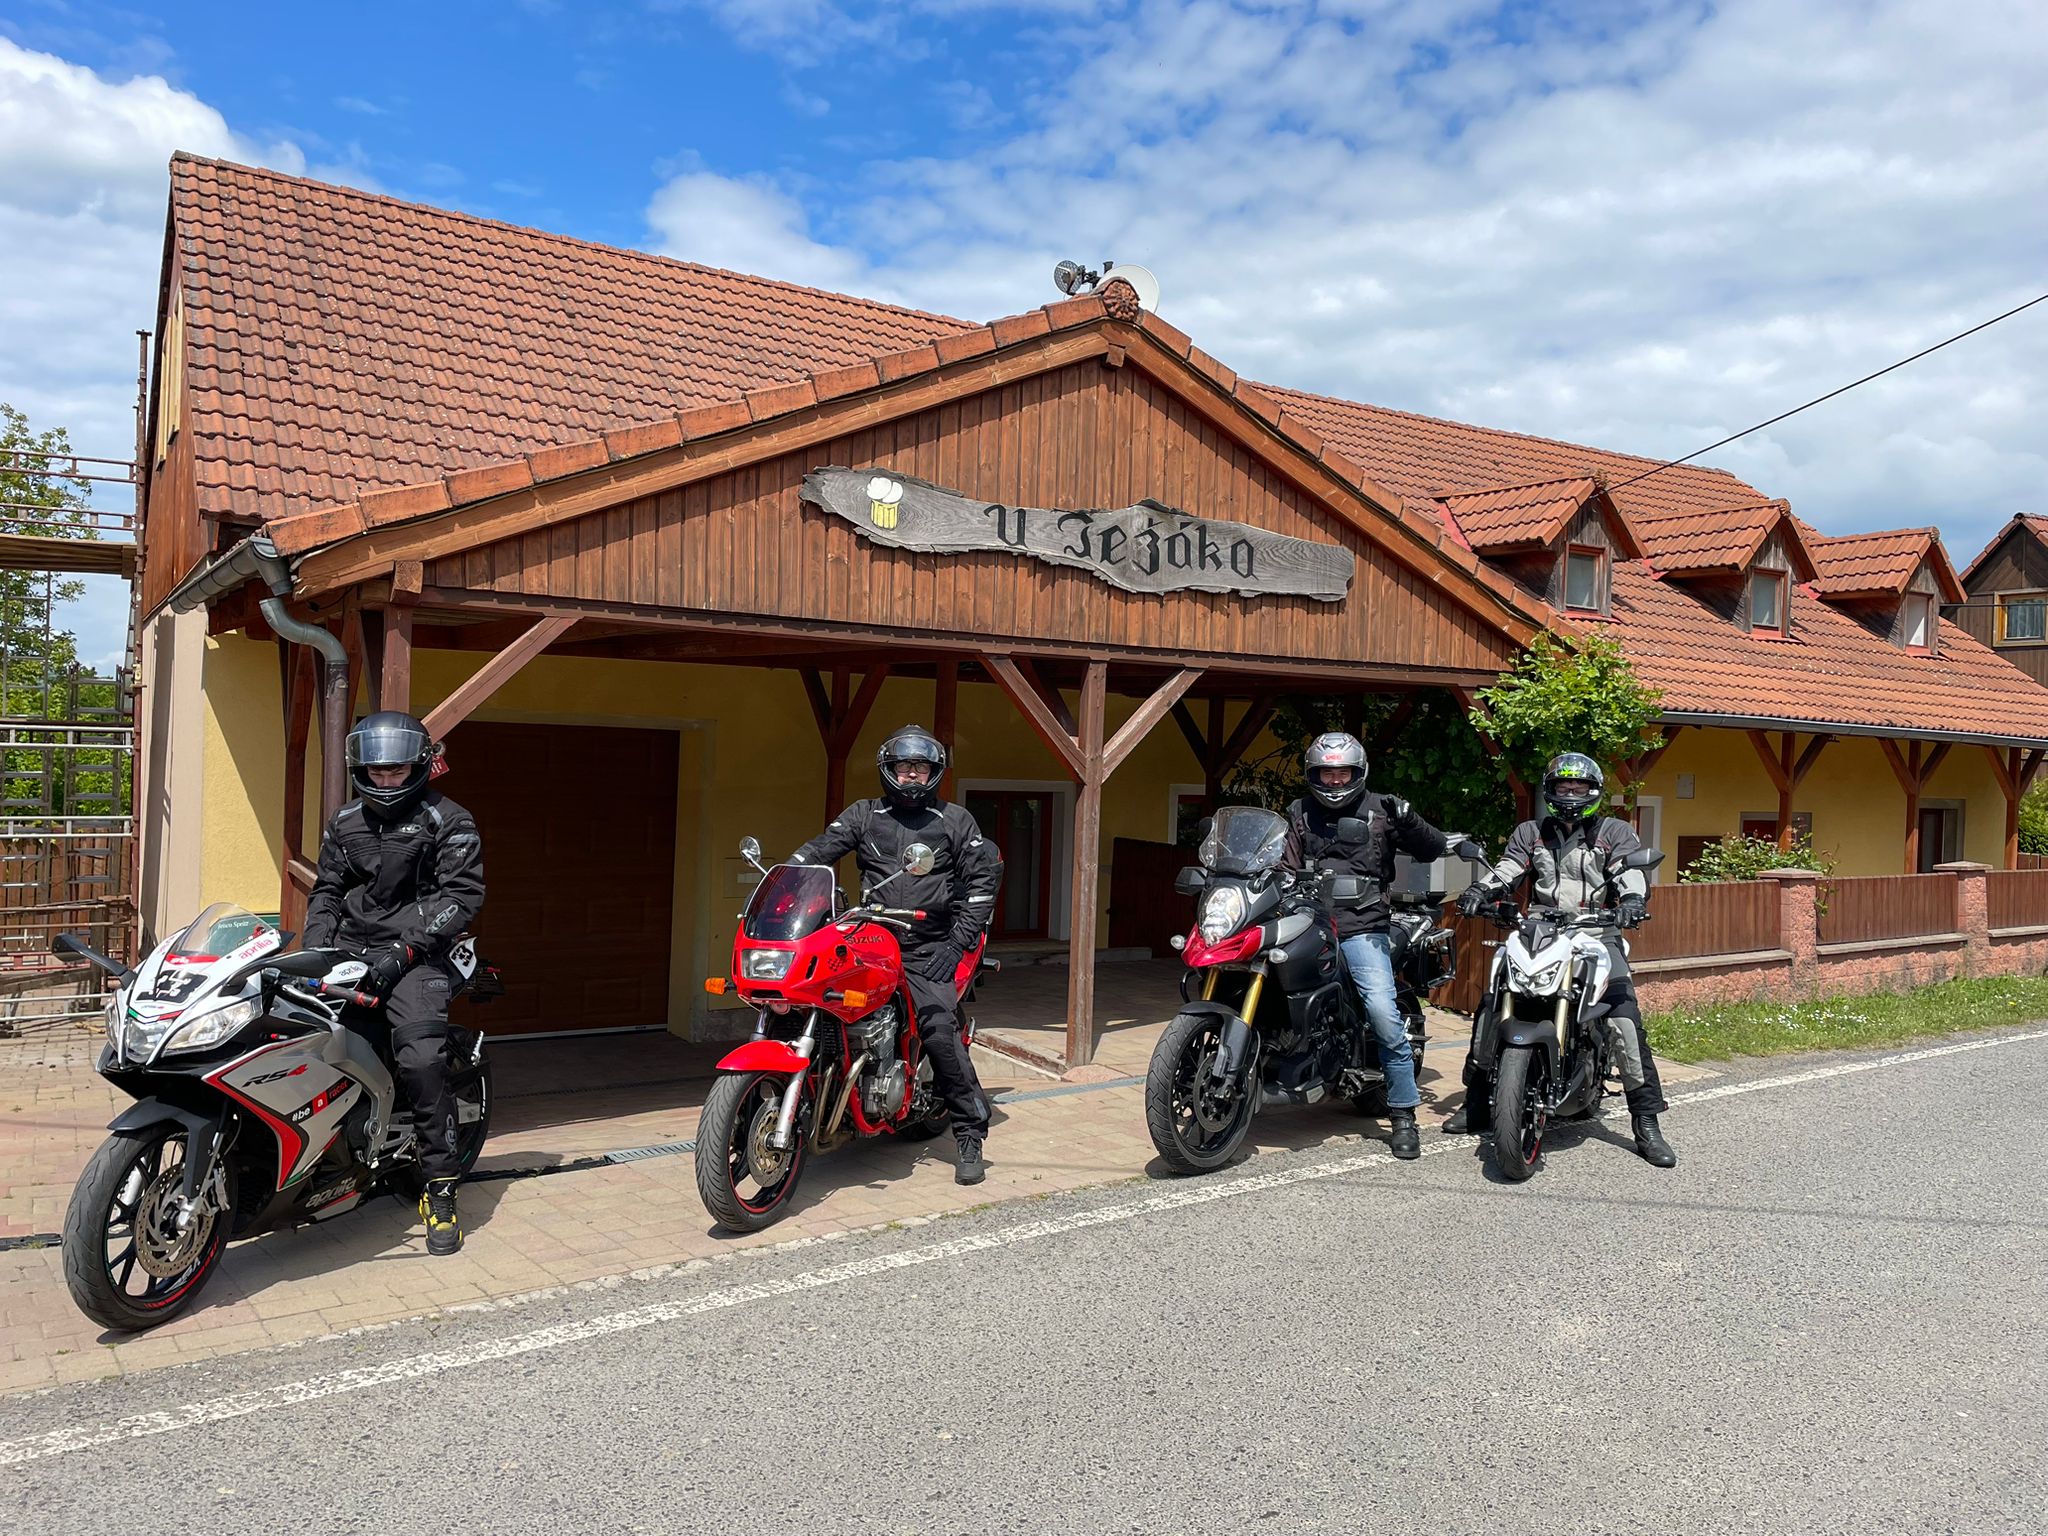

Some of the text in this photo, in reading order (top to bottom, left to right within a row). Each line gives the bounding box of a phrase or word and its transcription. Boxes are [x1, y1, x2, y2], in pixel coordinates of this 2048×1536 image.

[983, 504, 1028, 549] U
[239, 938, 273, 960] aprilia
[847, 935, 885, 944] SUZUKI
[242, 1063, 309, 1088] RS4
[292, 1107, 311, 1122] #be
